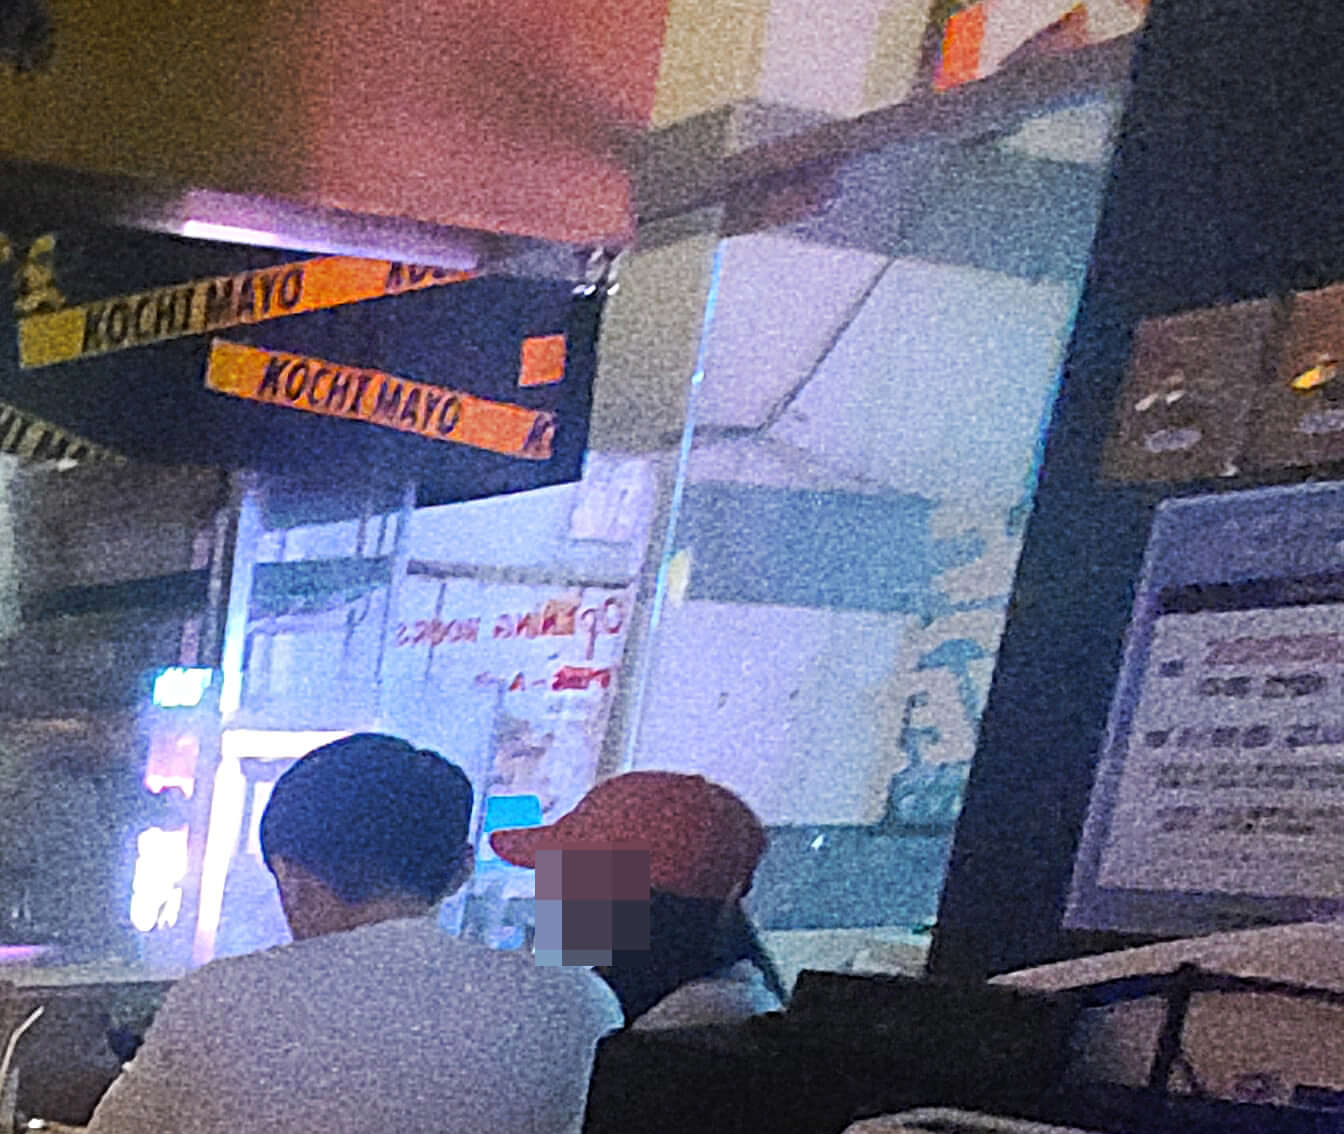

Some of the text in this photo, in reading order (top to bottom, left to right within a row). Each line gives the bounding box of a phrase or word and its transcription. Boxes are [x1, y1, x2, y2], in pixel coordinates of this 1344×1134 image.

[82, 266, 305, 352] KOCHI MAYO
[260, 352, 462, 436] KOCHI MAYO
